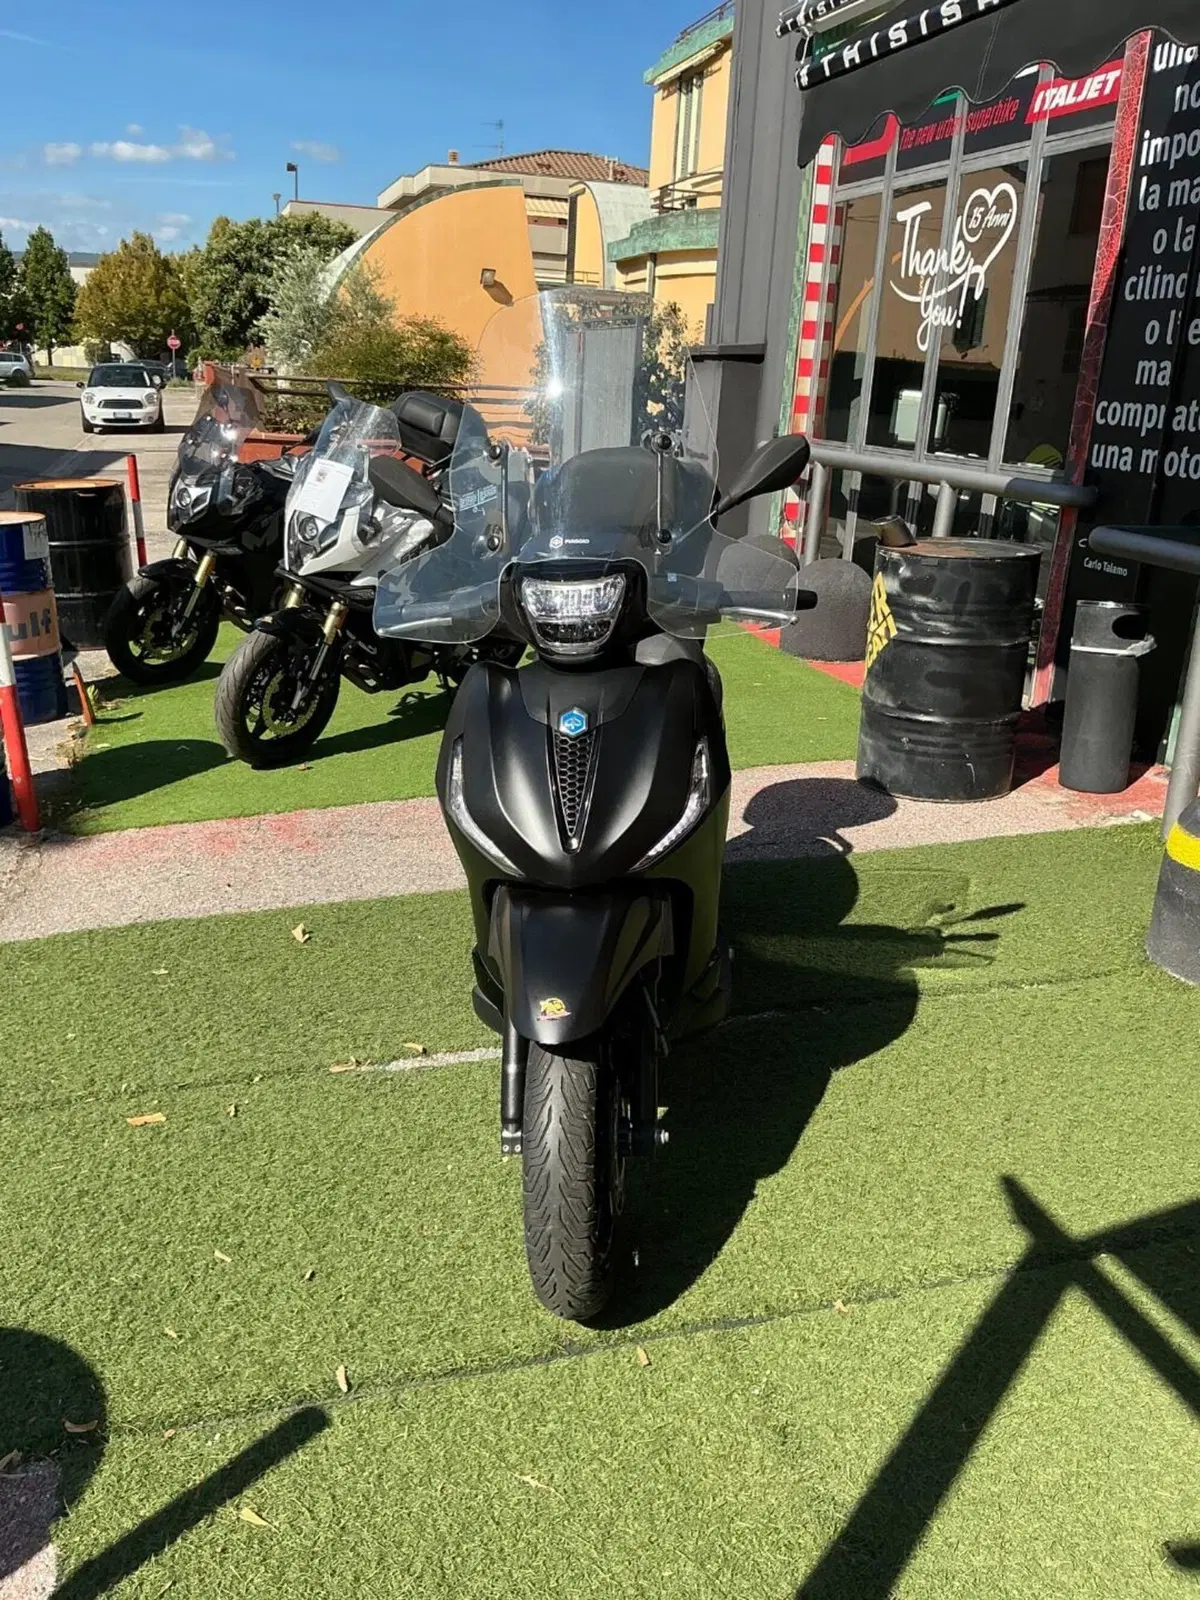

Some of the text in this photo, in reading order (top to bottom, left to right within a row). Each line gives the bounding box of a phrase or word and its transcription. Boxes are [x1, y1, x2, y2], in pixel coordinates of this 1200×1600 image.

[1033, 69, 1122, 114] ITALJET
[964, 97, 1020, 135] superbike
[1138, 175, 1161, 212] la
[968, 205, 1013, 229] 15 Anni
[896, 201, 971, 279] Thank
[1153, 216, 1196, 254] o la
[1145, 319, 1160, 345] o
[1135, 359, 1172, 387] ma
[1091, 443, 1133, 472] una
[1083, 557, 1128, 577] Carlo Talamo
[4, 608, 51, 642] ulf
